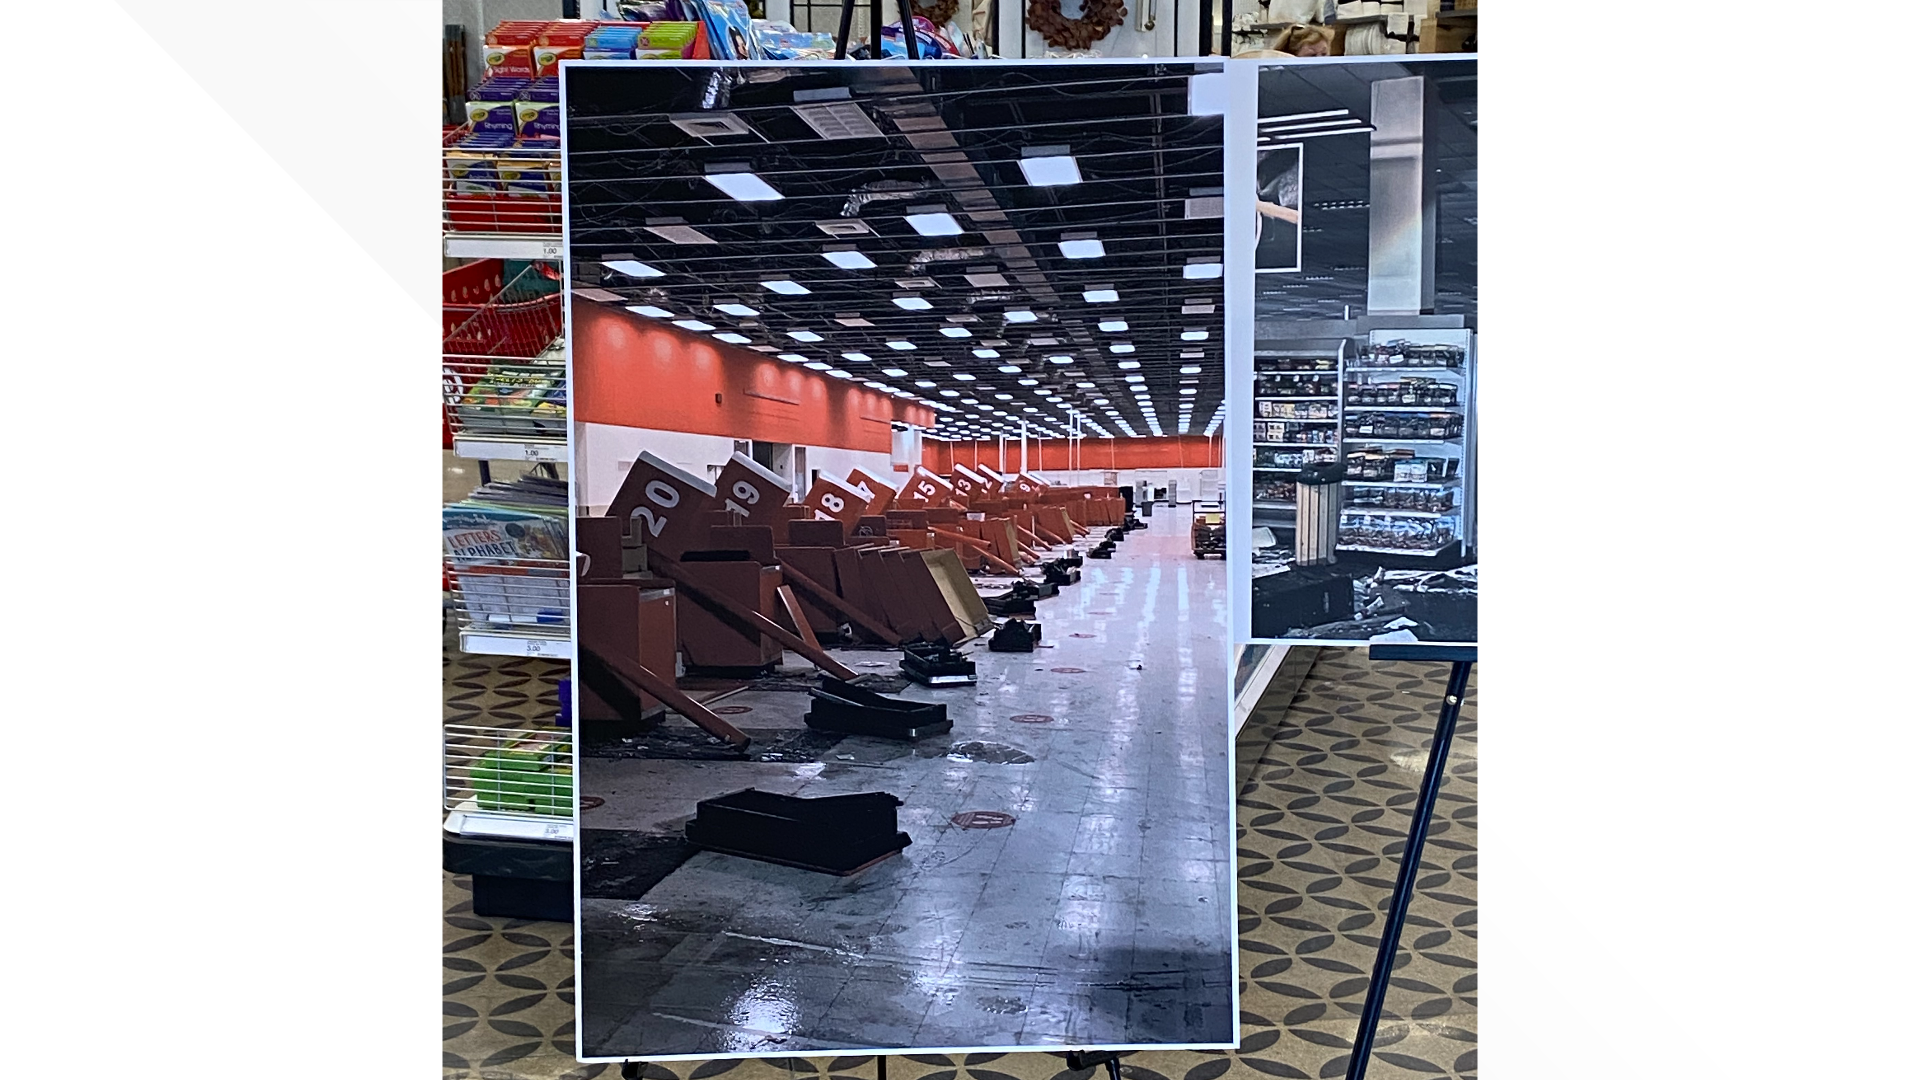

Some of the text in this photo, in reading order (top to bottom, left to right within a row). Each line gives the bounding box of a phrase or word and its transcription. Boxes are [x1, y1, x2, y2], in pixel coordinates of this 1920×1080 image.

[510, 65, 531, 74] Words
[483, 121, 513, 131] Rhyming
[533, 121, 560, 131] Rhymin
[543, 247, 558, 255] 1.00
[525, 449, 539, 457] 1.00
[912, 480, 936, 503] 15
[954, 478, 972, 497] 13
[629, 479, 680, 538] 20
[724, 480, 760, 519] 19
[813, 492, 845, 521] 18
[446, 529, 502, 549] LETTERS
[453, 540, 516, 562] ALPHABET
